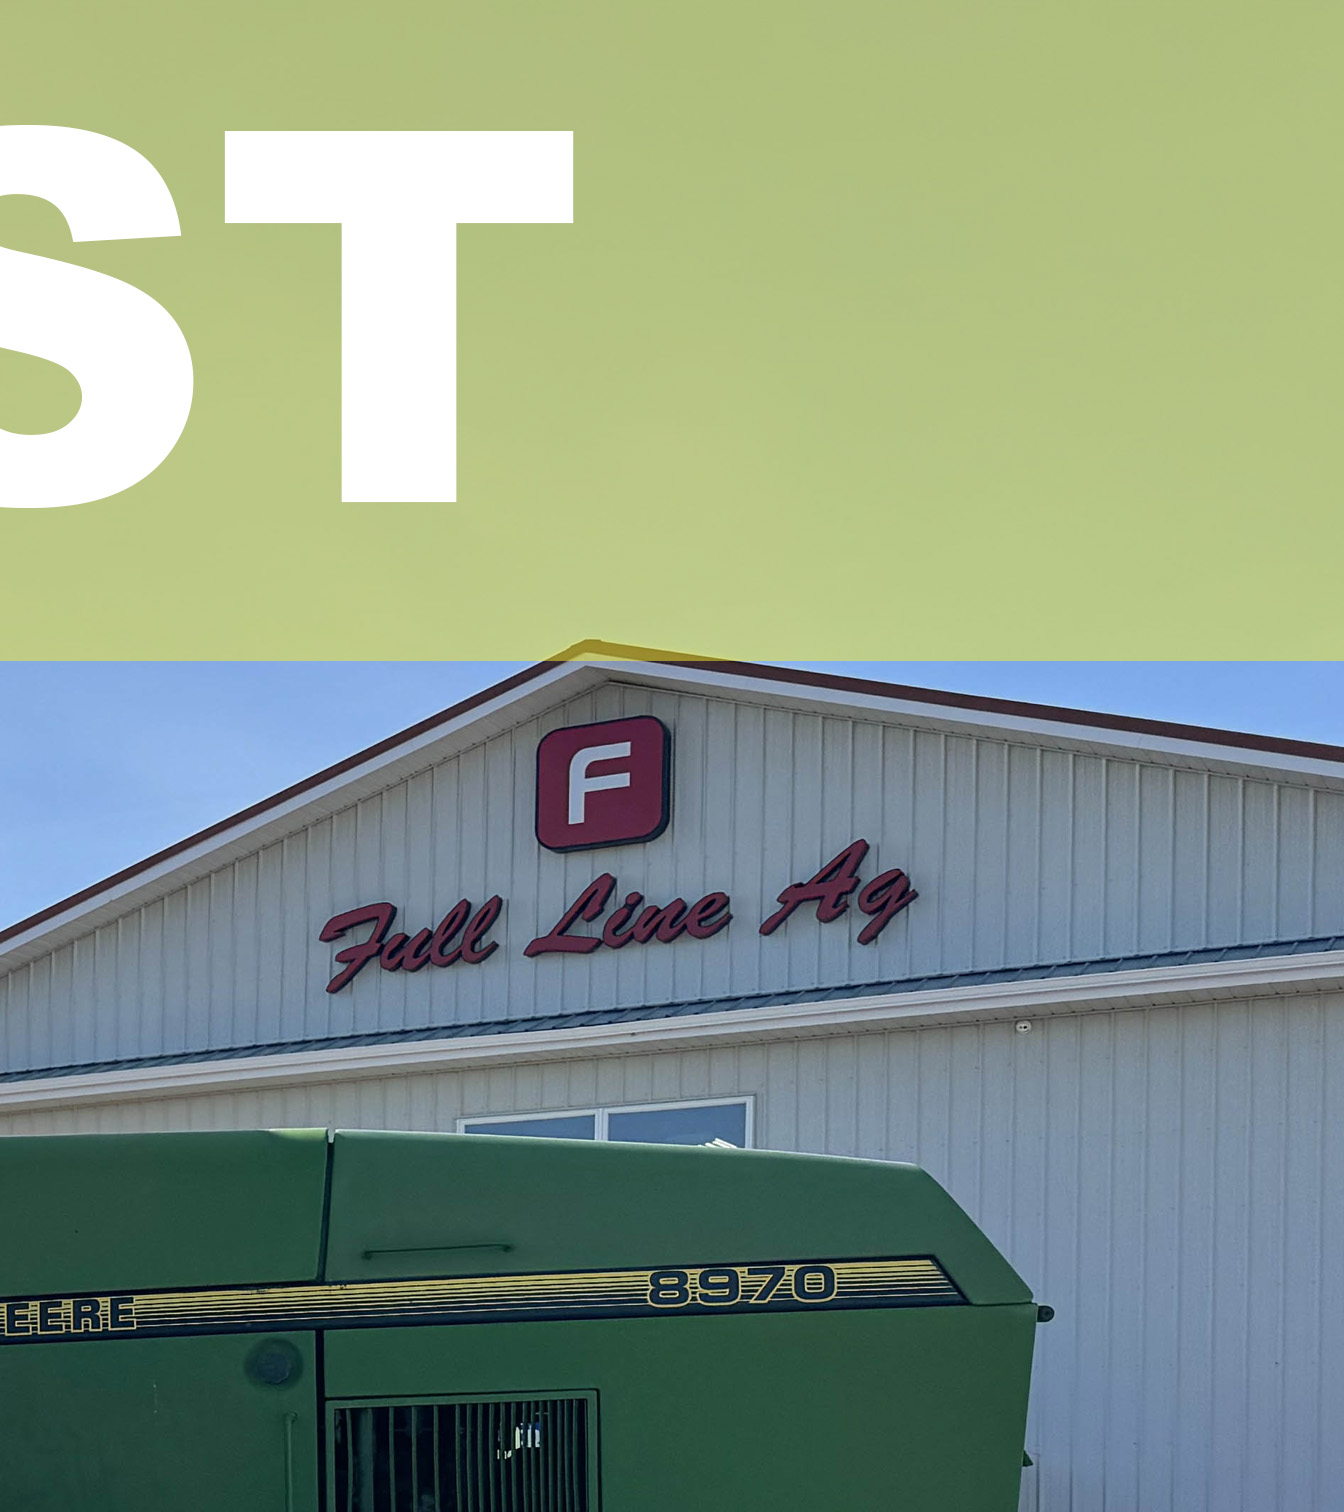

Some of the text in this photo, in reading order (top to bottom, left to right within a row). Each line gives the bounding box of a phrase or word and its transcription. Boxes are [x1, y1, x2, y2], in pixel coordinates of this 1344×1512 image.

[568, 741, 632, 825] F
[319, 838, 919, 994] Full Line Ag
[647, 1263, 838, 1308] 8970
